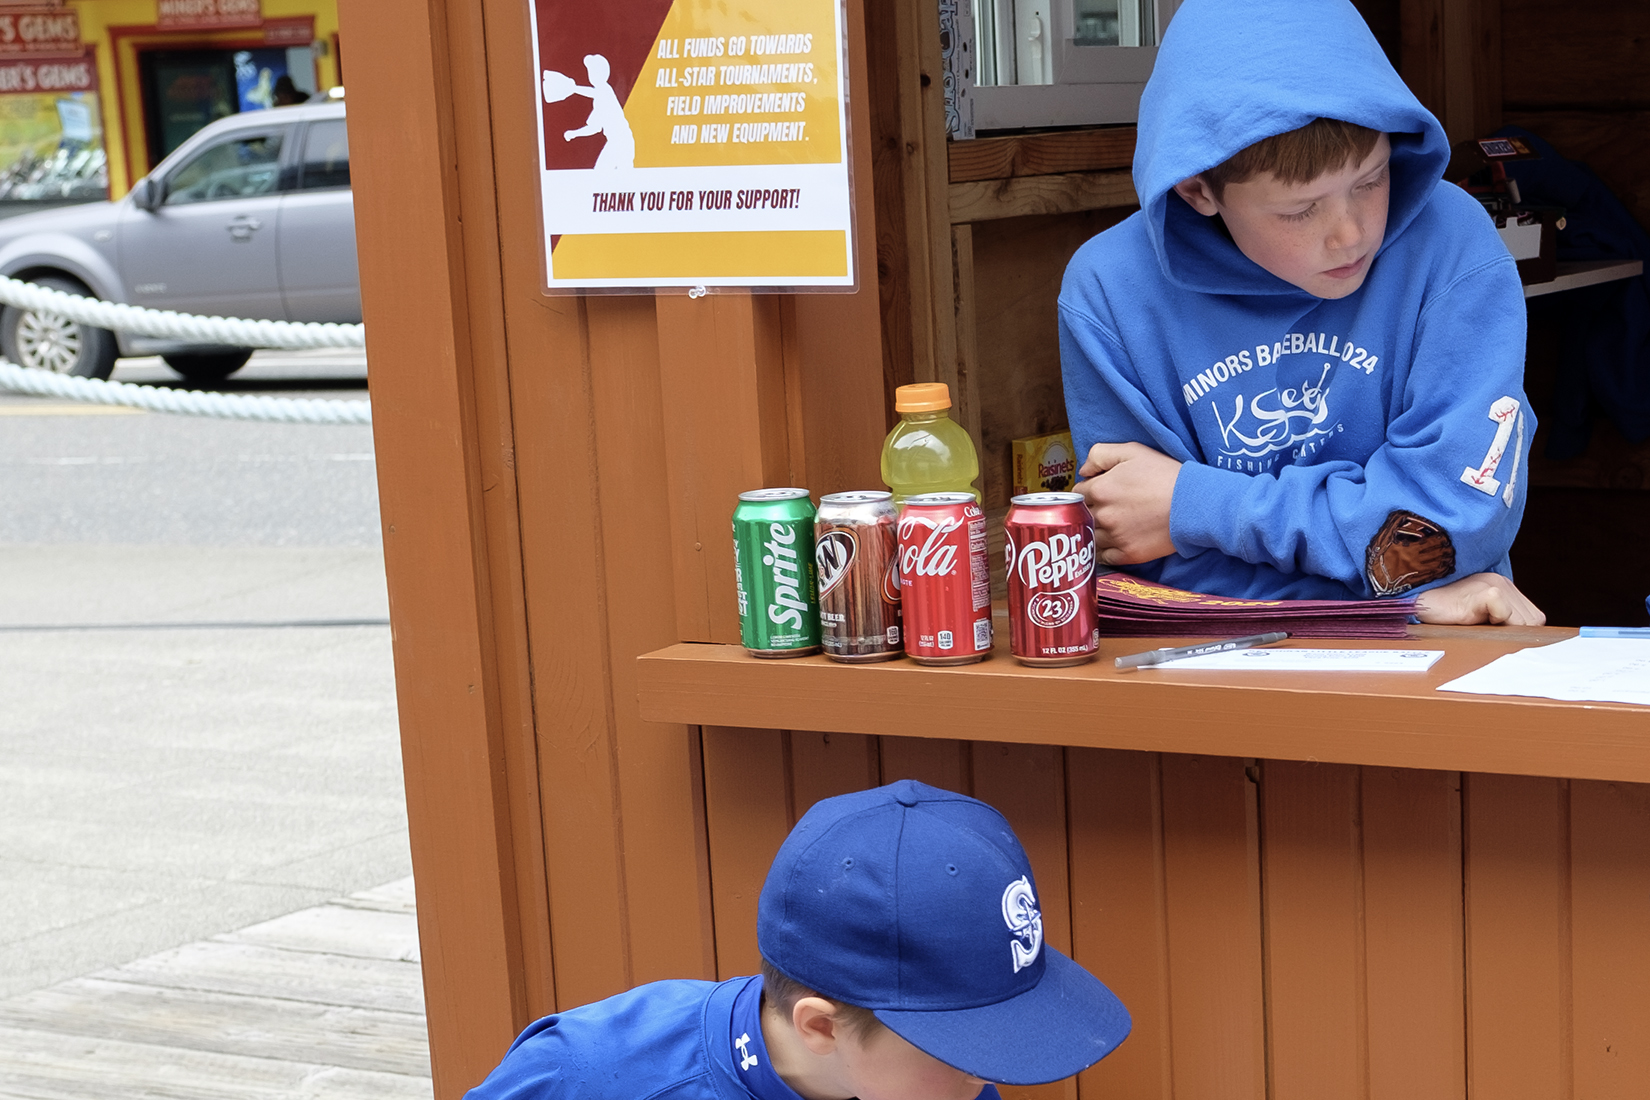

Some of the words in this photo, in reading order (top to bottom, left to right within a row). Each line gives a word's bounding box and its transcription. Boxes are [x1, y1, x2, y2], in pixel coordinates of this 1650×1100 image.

[18, 15, 77, 42] GEMS
[657, 38, 680, 59] ALL
[683, 36, 725, 58] FUNDS
[728, 35, 746, 57] GO
[750, 33, 814, 55] TOWARDS
[38, 63, 90, 89] GEMS
[656, 65, 716, 88] ALL-STAR
[719, 62, 818, 86] TOURNAMENTS,
[667, 94, 701, 116] FIELD
[704, 92, 807, 115] IMPROVEMENTS
[670, 124, 697, 145] AND
[700, 123, 729, 144] NEW
[732, 121, 810, 144] EQUIPMENT.
[592, 191, 636, 213] THANK
[639, 190, 666, 212] YOU
[668, 189, 694, 211] FOR
[697, 189, 732, 211] YOUR
[735, 187, 801, 210] SUPPORT!
[1182, 350, 1253, 407] MINORS
[1340, 341, 1380, 376] 024
[1038, 458, 1075, 480] Raisinets
[1048, 533, 1082, 562] Dr
[762, 522, 809, 631] Sprite
[1018, 539, 1095, 590] Pepper
[1041, 599, 1063, 619] 23
[1001, 874, 1043, 974] S
